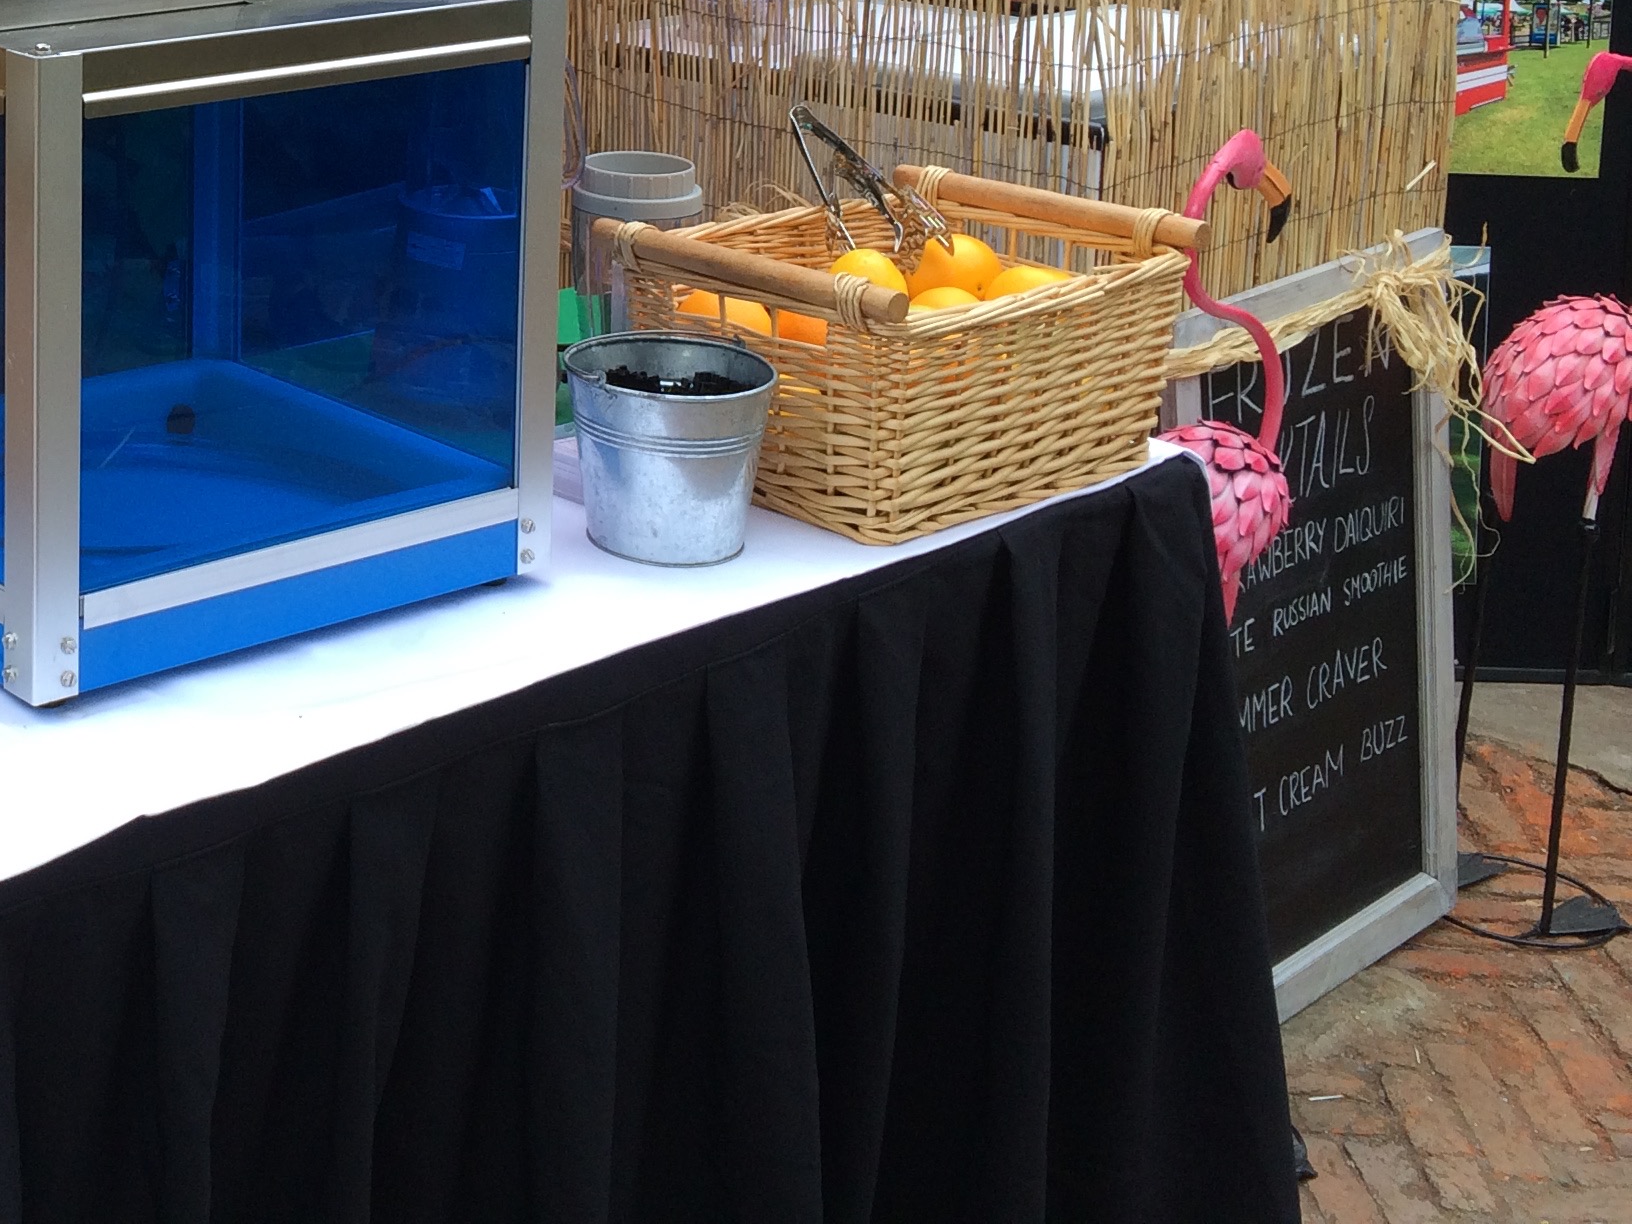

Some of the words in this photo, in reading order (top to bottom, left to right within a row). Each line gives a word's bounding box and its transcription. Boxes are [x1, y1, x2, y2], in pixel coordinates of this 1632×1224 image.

[1333, 496, 1405, 554] DAIQUIRI
[1272, 587, 1332, 637] RUSSIAN
[1342, 555, 1409, 607] SMOOTHIE
[1239, 675, 1294, 734] MMER
[1306, 636, 1389, 710] CRAVER
[1278, 743, 1345, 817] CREAM
[1359, 714, 1409, 764] BUZZ
